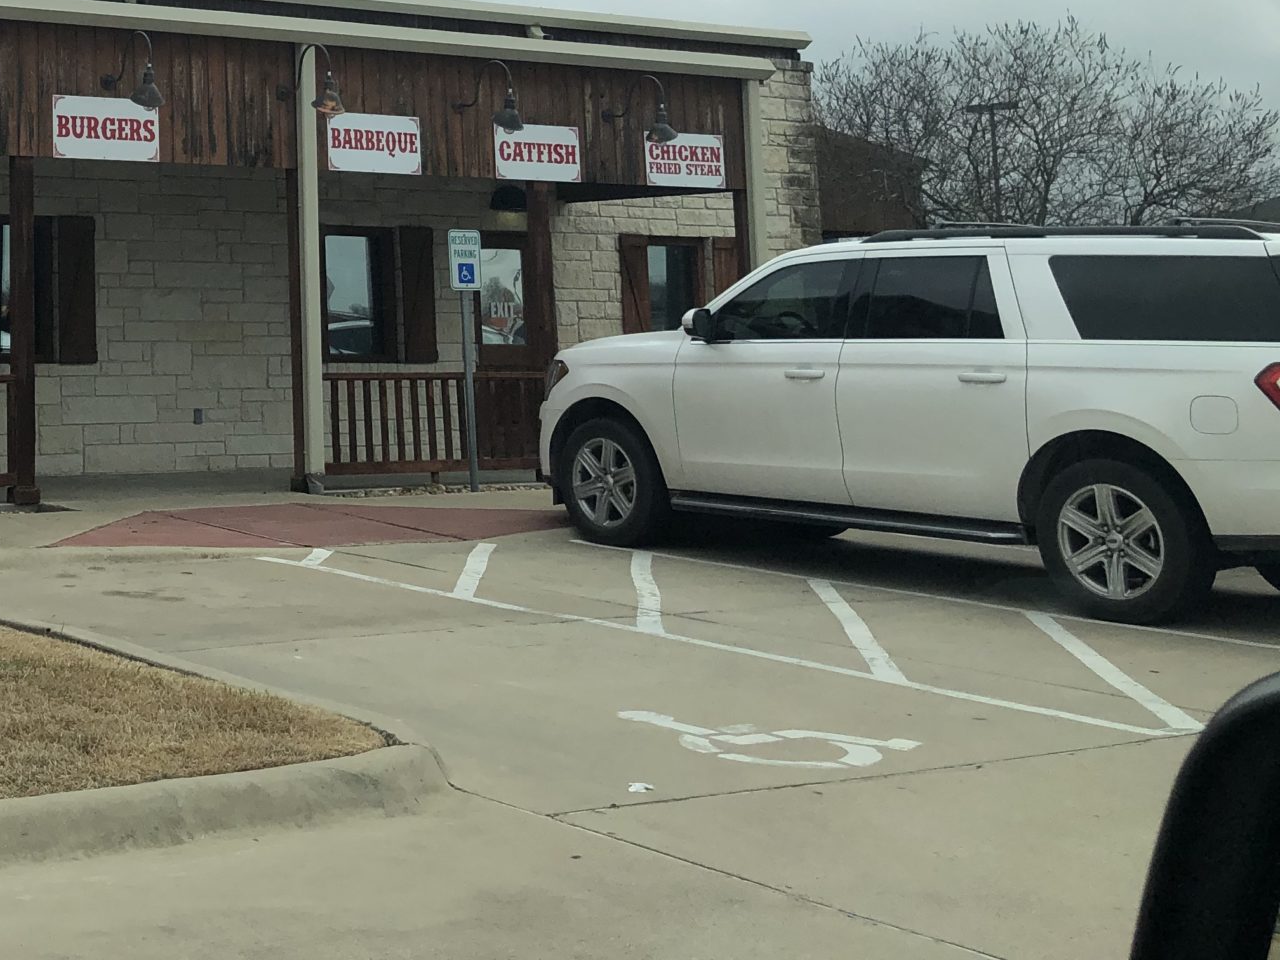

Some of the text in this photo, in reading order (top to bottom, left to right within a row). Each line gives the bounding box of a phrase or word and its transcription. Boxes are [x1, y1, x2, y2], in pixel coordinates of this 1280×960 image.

[56, 114, 156, 142] BURGERS
[331, 128, 418, 157] BARBEQUE
[499, 140, 577, 165] CATFISH
[648, 143, 721, 163] CHICKEN
[648, 162, 723, 176] FRIED STEAK
[450, 235, 478, 246] RESERVED
[453, 249, 476, 259] PARKING
[490, 301, 514, 318] EXIT
